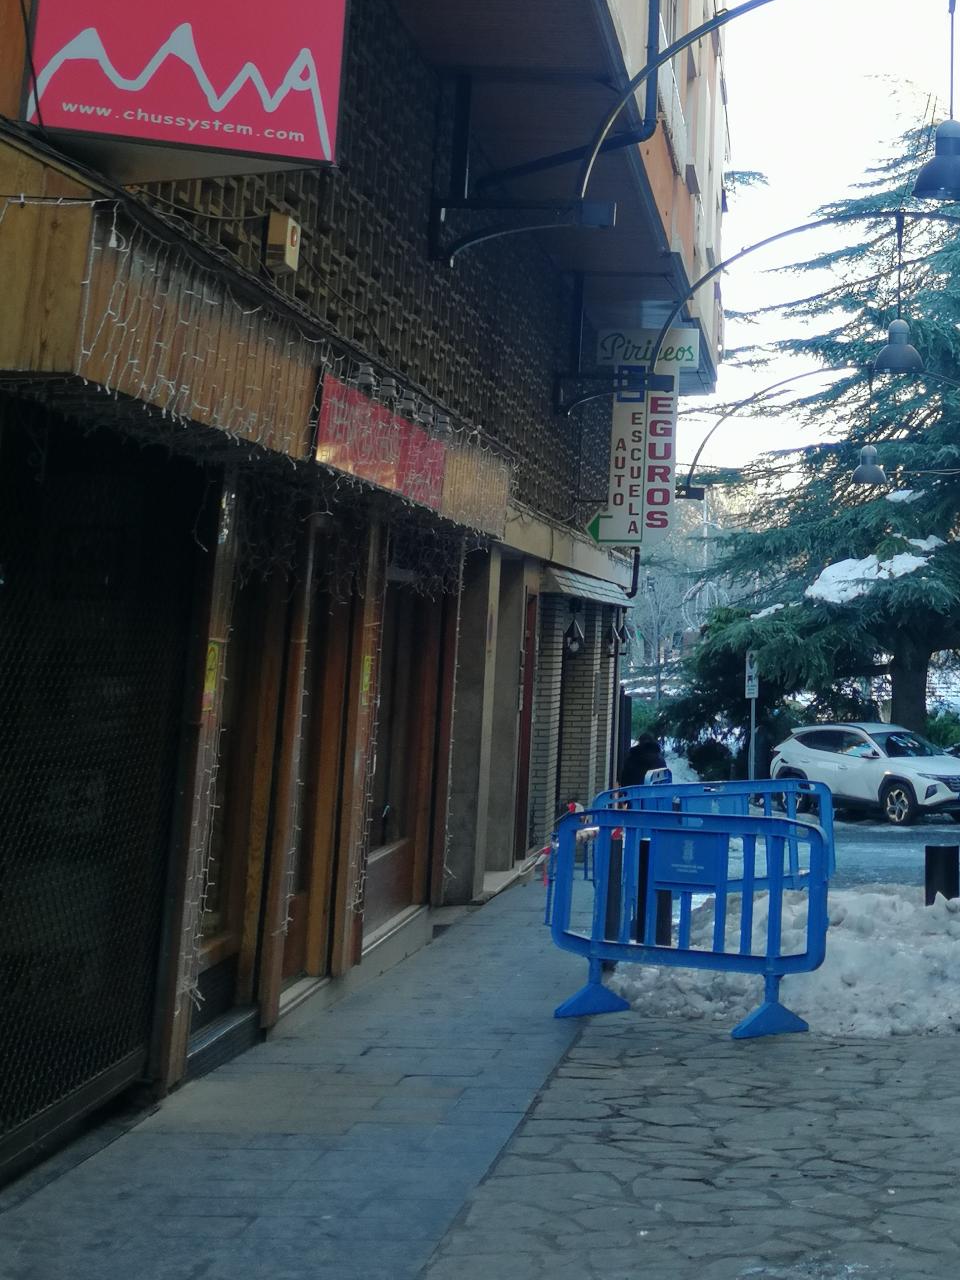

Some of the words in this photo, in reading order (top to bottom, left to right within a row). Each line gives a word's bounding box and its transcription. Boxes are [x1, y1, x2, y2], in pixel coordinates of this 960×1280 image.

[62, 101, 305, 142] www.chussystem.com
[601, 333, 695, 362] Pirieos
[613, 438, 626, 506] AUTO
[627, 412, 643, 534] ESCUELA
[645, 396, 673, 529] EGUROS
